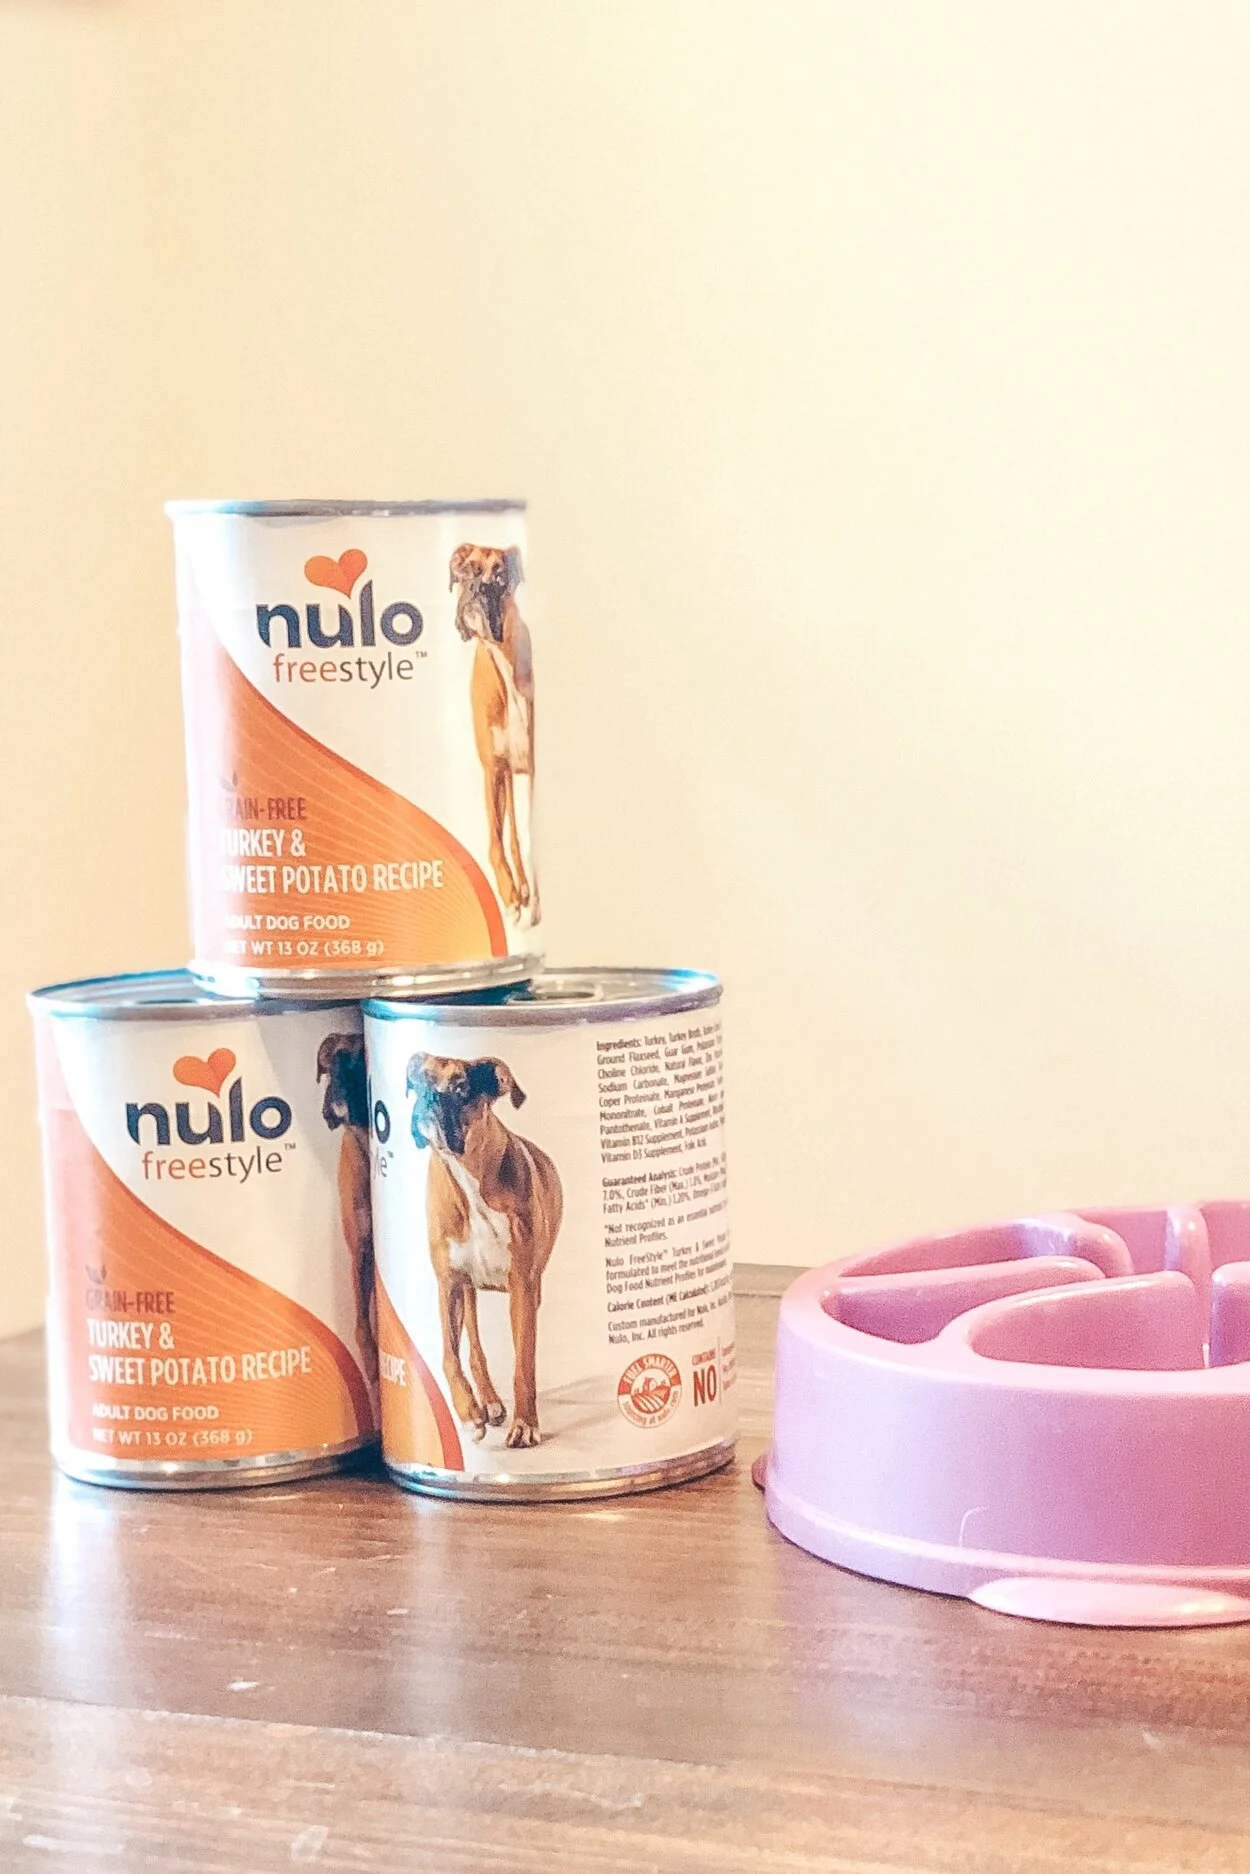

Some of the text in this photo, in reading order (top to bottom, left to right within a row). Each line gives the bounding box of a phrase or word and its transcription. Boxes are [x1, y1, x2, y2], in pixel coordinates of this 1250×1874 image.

[256, 579, 423, 648] nulo
[290, 828, 306, 857] &
[282, 864, 367, 894] POTATO
[372, 860, 443, 891] RECIPE
[266, 915, 299, 930] DOG
[303, 914, 350, 930] FOOD
[249, 941, 273, 956] WT
[277, 941, 292, 956] 13
[296, 941, 318, 956] OZ
[324, 940, 362, 956] (368
[366, 940, 385, 956] g)
[596, 1038, 642, 1052] Ingredients:
[597, 1053, 625, 1065] Ground
[125, 1076, 292, 1145] nulo
[600, 1138, 631, 1150] Vitamin
[601, 1152, 632, 1163] Vitamin
[602, 1174, 646, 1187] Guaranteed
[603, 1202, 623, 1214] Fatty
[605, 1235, 637, 1248] Nutrient
[606, 1266, 650, 1281] formulated
[606, 1283, 623, 1294] Dog
[624, 1280, 643, 1291] Food
[86, 1290, 176, 1314] GRAIN-FREE
[607, 1301, 634, 1313] Calorie
[636, 1296, 664, 1309] Content
[86, 1318, 174, 1349] TURKEY &
[608, 1320, 638, 1332] Custom
[88, 1346, 312, 1385] SWEET POTATO RECIPE
[693, 1364, 717, 1407] NO
[92, 1404, 219, 1420] ADULT DOG FOOD
[92, 1428, 252, 1446] NET WT 13 OZ (368 g)
